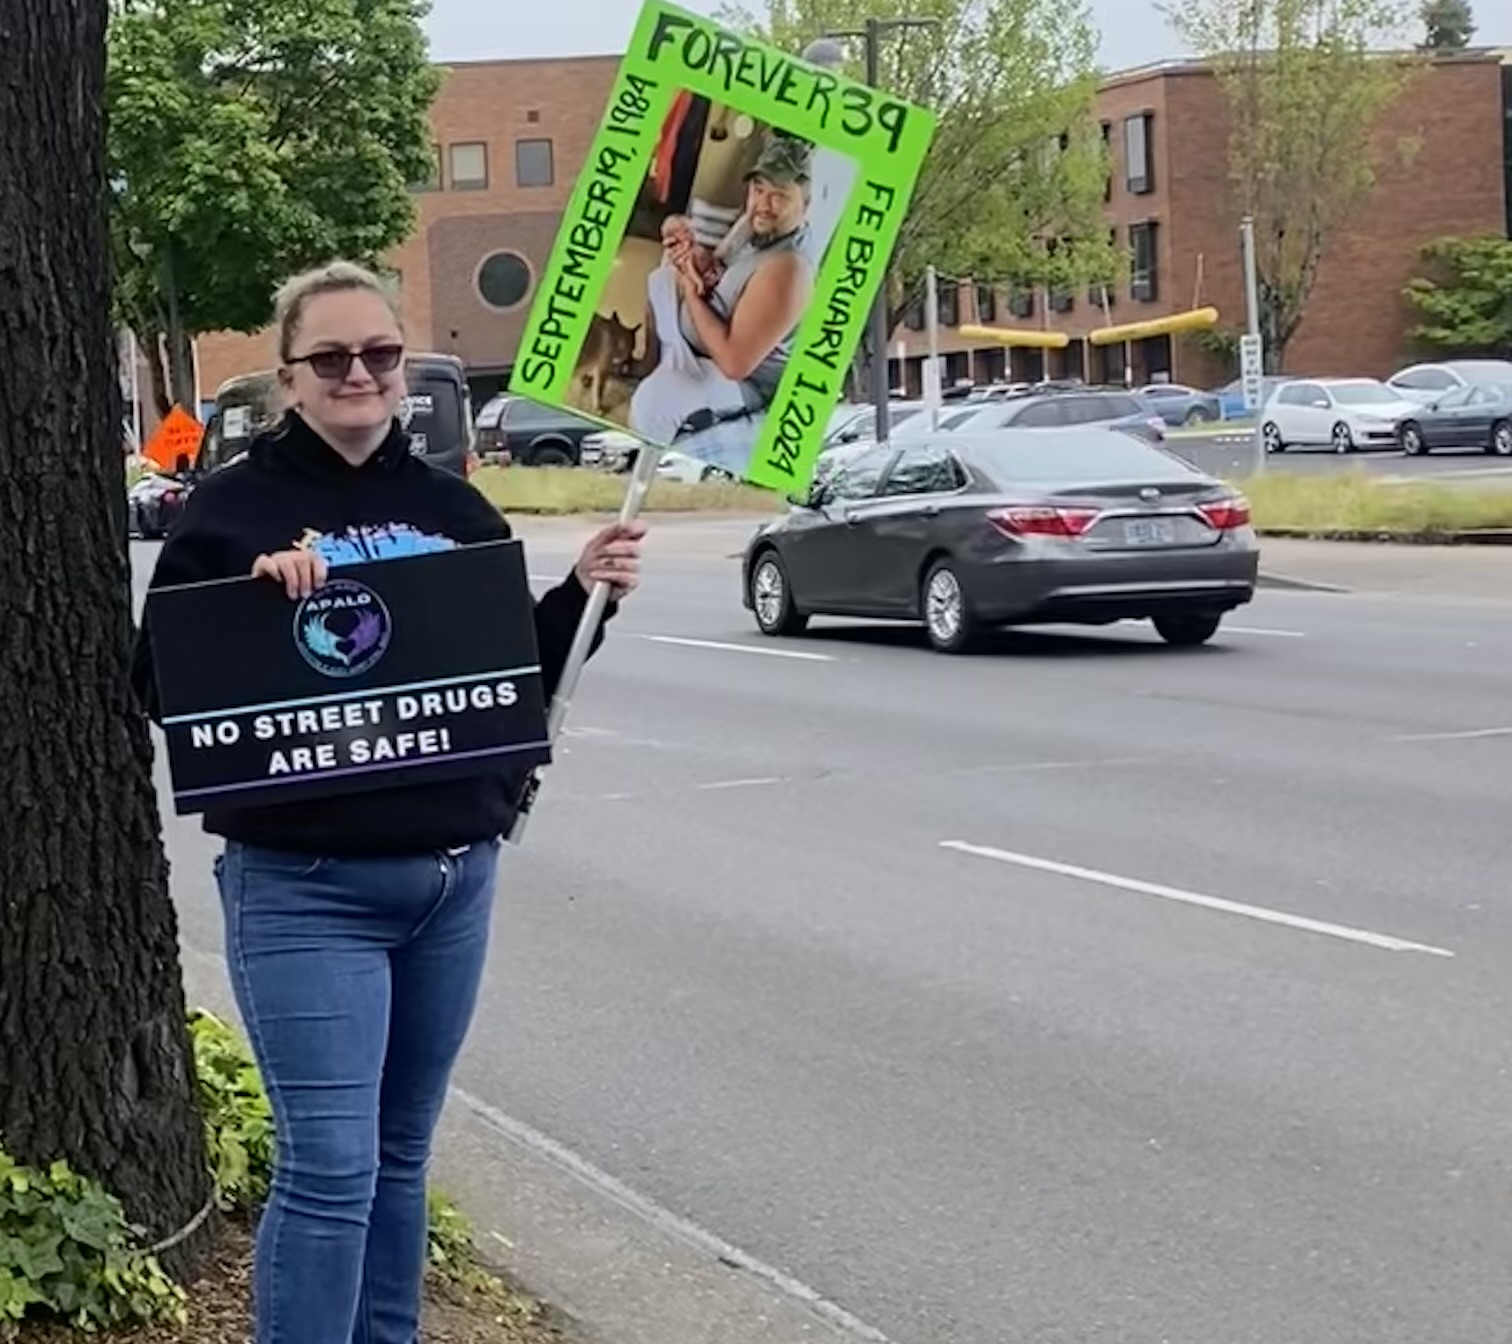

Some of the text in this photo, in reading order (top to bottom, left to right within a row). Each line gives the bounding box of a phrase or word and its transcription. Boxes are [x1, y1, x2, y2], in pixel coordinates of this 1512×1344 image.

[647, 12, 909, 153] FOREVER 39
[521, 179, 623, 391] SEPTEMBER
[606, 72, 659, 137] 1984
[191, 681, 517, 748] NO STREET DRUGS
[269, 728, 450, 775] ARE SAFE!
